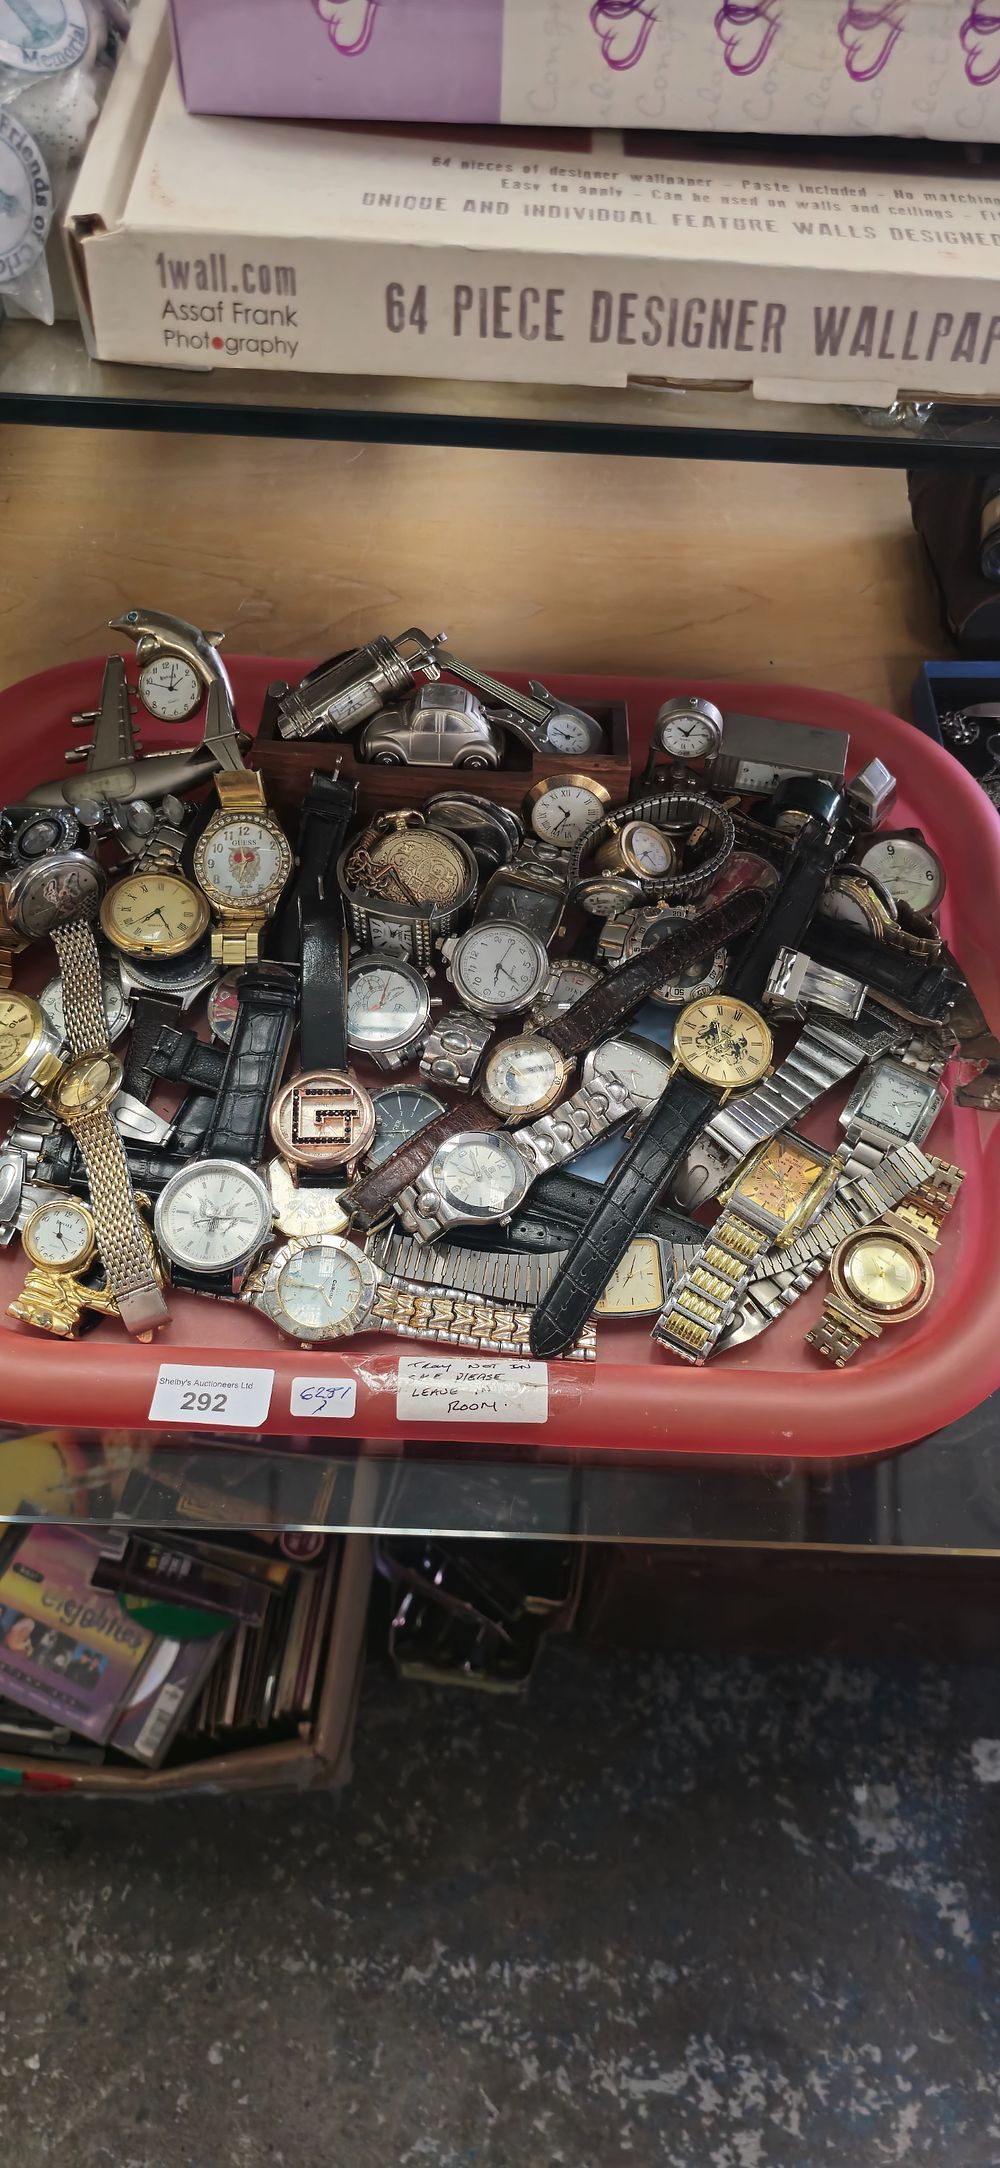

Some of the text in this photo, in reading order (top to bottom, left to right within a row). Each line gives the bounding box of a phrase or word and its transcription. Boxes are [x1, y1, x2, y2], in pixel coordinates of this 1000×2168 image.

[460, 158, 514, 174] pieces
[522, 163, 540, 175] of
[549, 165, 620, 181] designer
[629, 173, 713, 190] wallpaper
[742, 179, 790, 193] Paste
[799, 183, 868, 197] included
[893, 189, 915, 201] No
[501, 178, 541, 193] Easy
[552, 181, 569, 194] to
[578, 185, 624, 199] apply
[651, 189, 684, 202] Can
[691, 191, 711, 204] be
[720, 194, 758, 207] used
[768, 198, 786, 209] on
[796, 200, 842, 213] walls
[850, 203, 881, 215] and
[888, 205, 954, 220] ceilings
[361, 192, 448, 212] UNIQUE
[462, 198, 510, 216] AND
[523, 203, 657, 226] INDIVIDUAL
[672, 212, 780, 234] FEATURE
[791, 221, 877, 240] WALLS
[155, 251, 298, 297] 1wall.com
[161, 299, 299, 329] Assaf Frank
[385, 281, 428, 336] 64
[453, 283, 566, 342] PIECE
[589, 289, 788, 355] DESIGNER
[159, 1377, 254, 1390] Shelby's Auctioneers Ltd
[180, 1391, 228, 1413] 292
